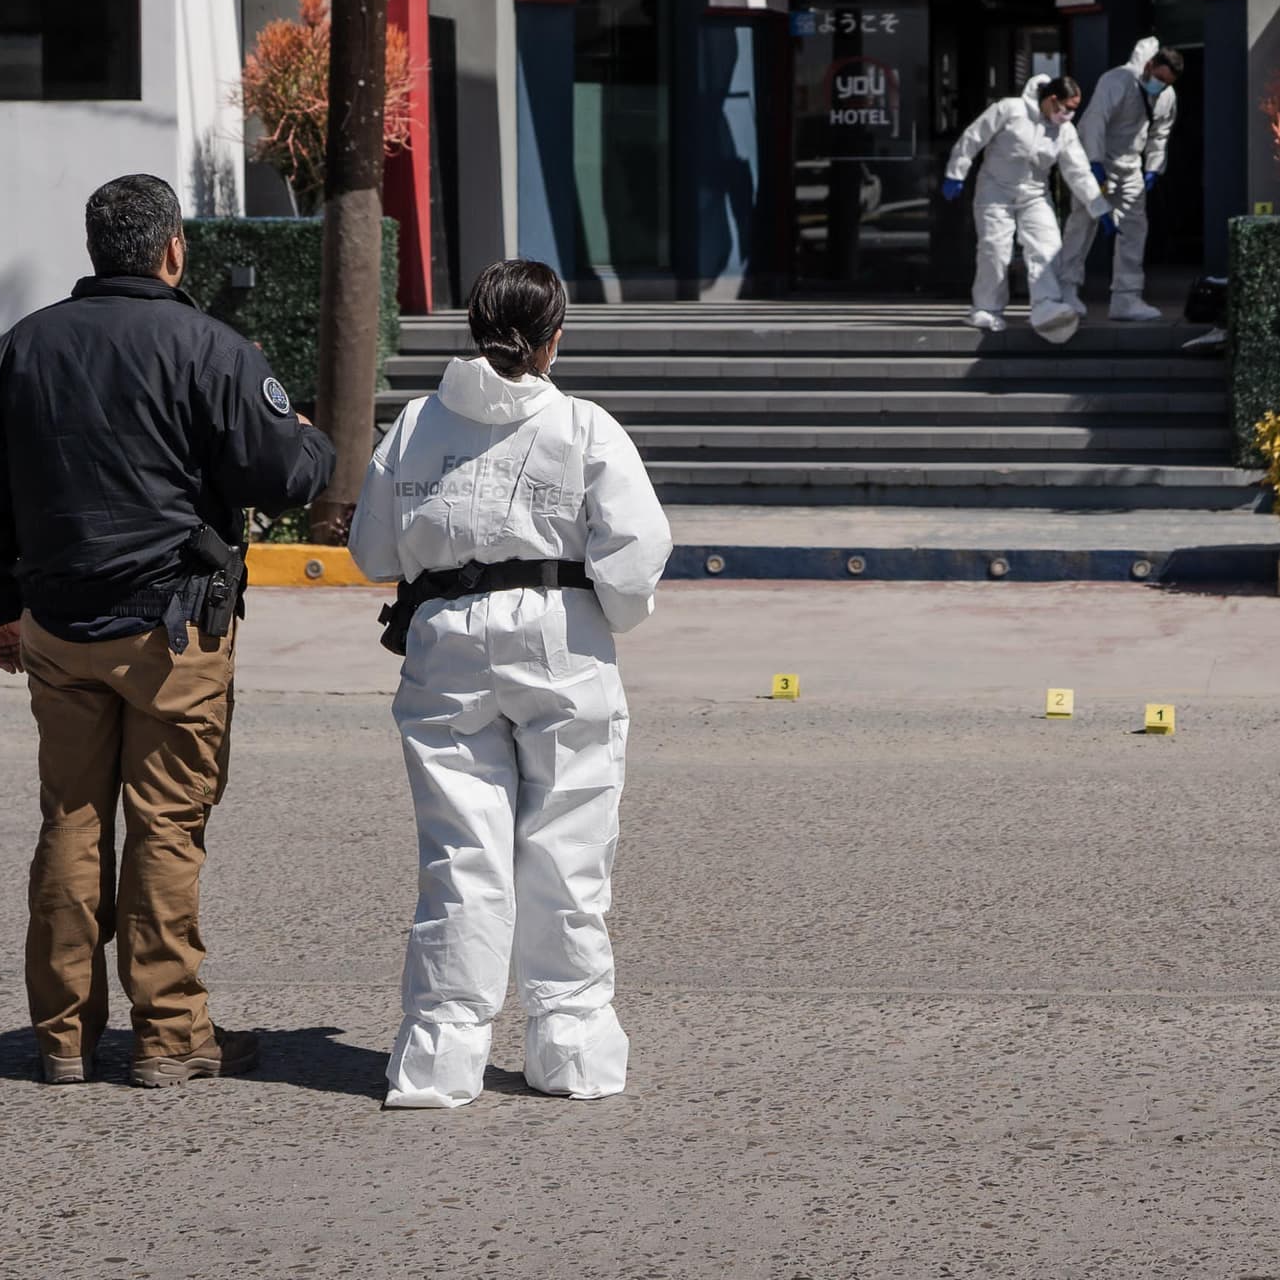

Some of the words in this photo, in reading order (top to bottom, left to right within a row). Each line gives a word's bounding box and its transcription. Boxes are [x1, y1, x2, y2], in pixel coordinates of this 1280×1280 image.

[817, 13, 900, 34] ようこそ
[830, 109, 889, 125] HOTEL
[780, 677, 790, 690] 3
[1054, 693, 1065, 706] 2
[1156, 709, 1164, 721] 1
